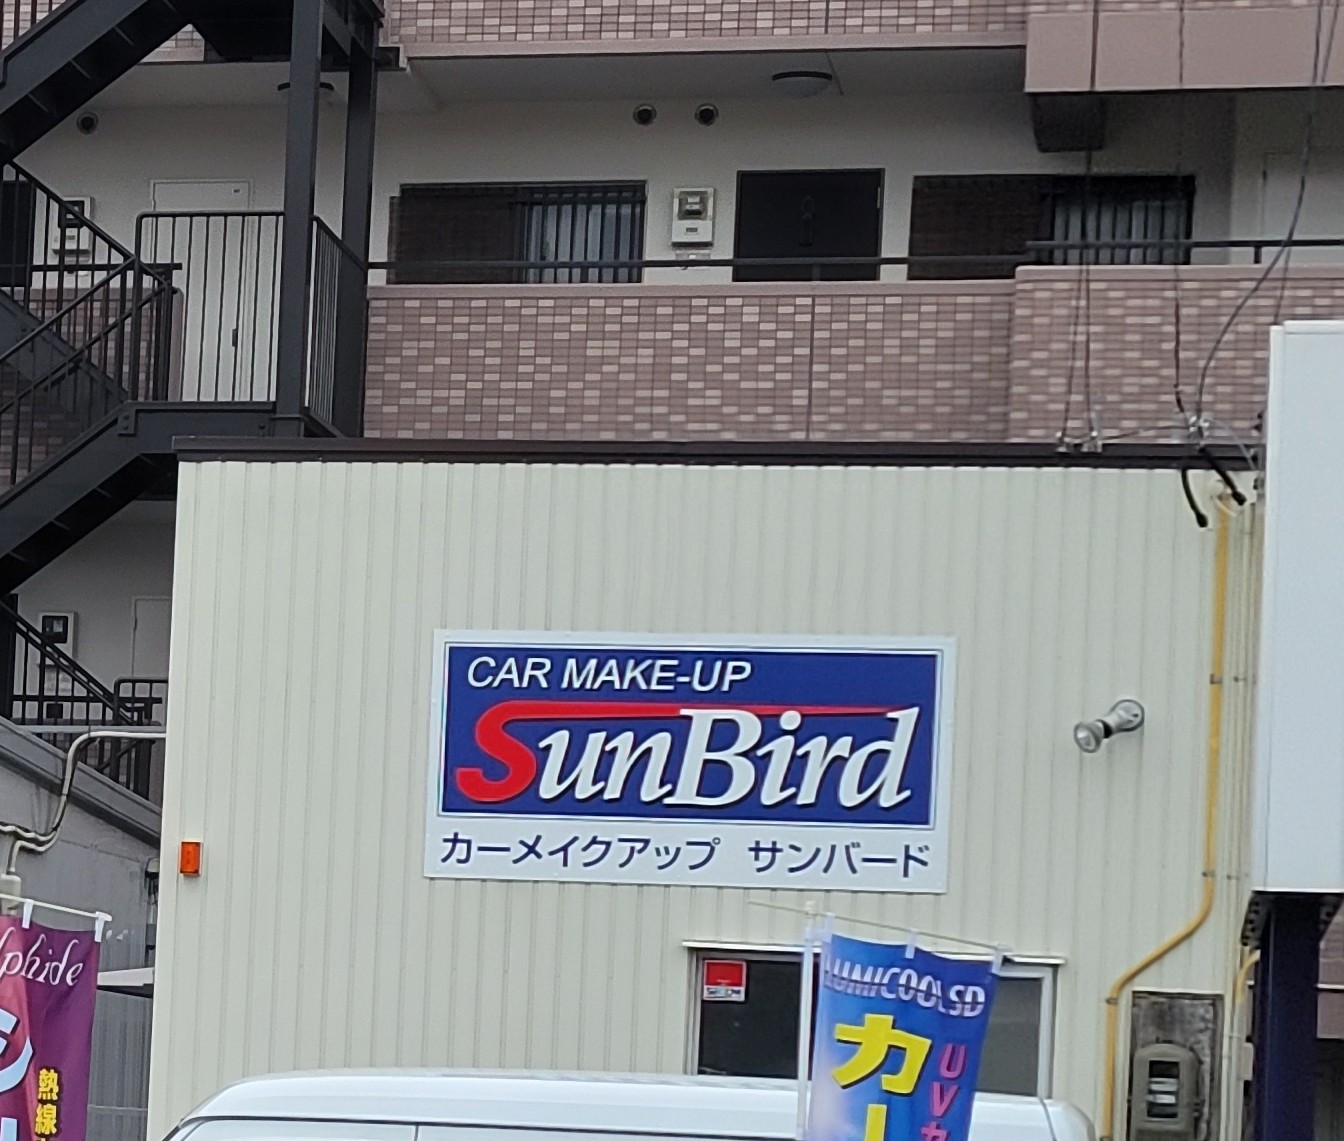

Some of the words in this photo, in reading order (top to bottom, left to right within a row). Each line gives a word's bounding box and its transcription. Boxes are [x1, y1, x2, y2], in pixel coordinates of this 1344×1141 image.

[467, 656, 550, 689] CAR
[561, 658, 752, 692] MAKE-UP
[455, 700, 919, 809] SunBird
[440, 831, 722, 872] カーメイクアップ
[748, 839, 930, 878] サンバード
[947, 984, 986, 1018] SD
